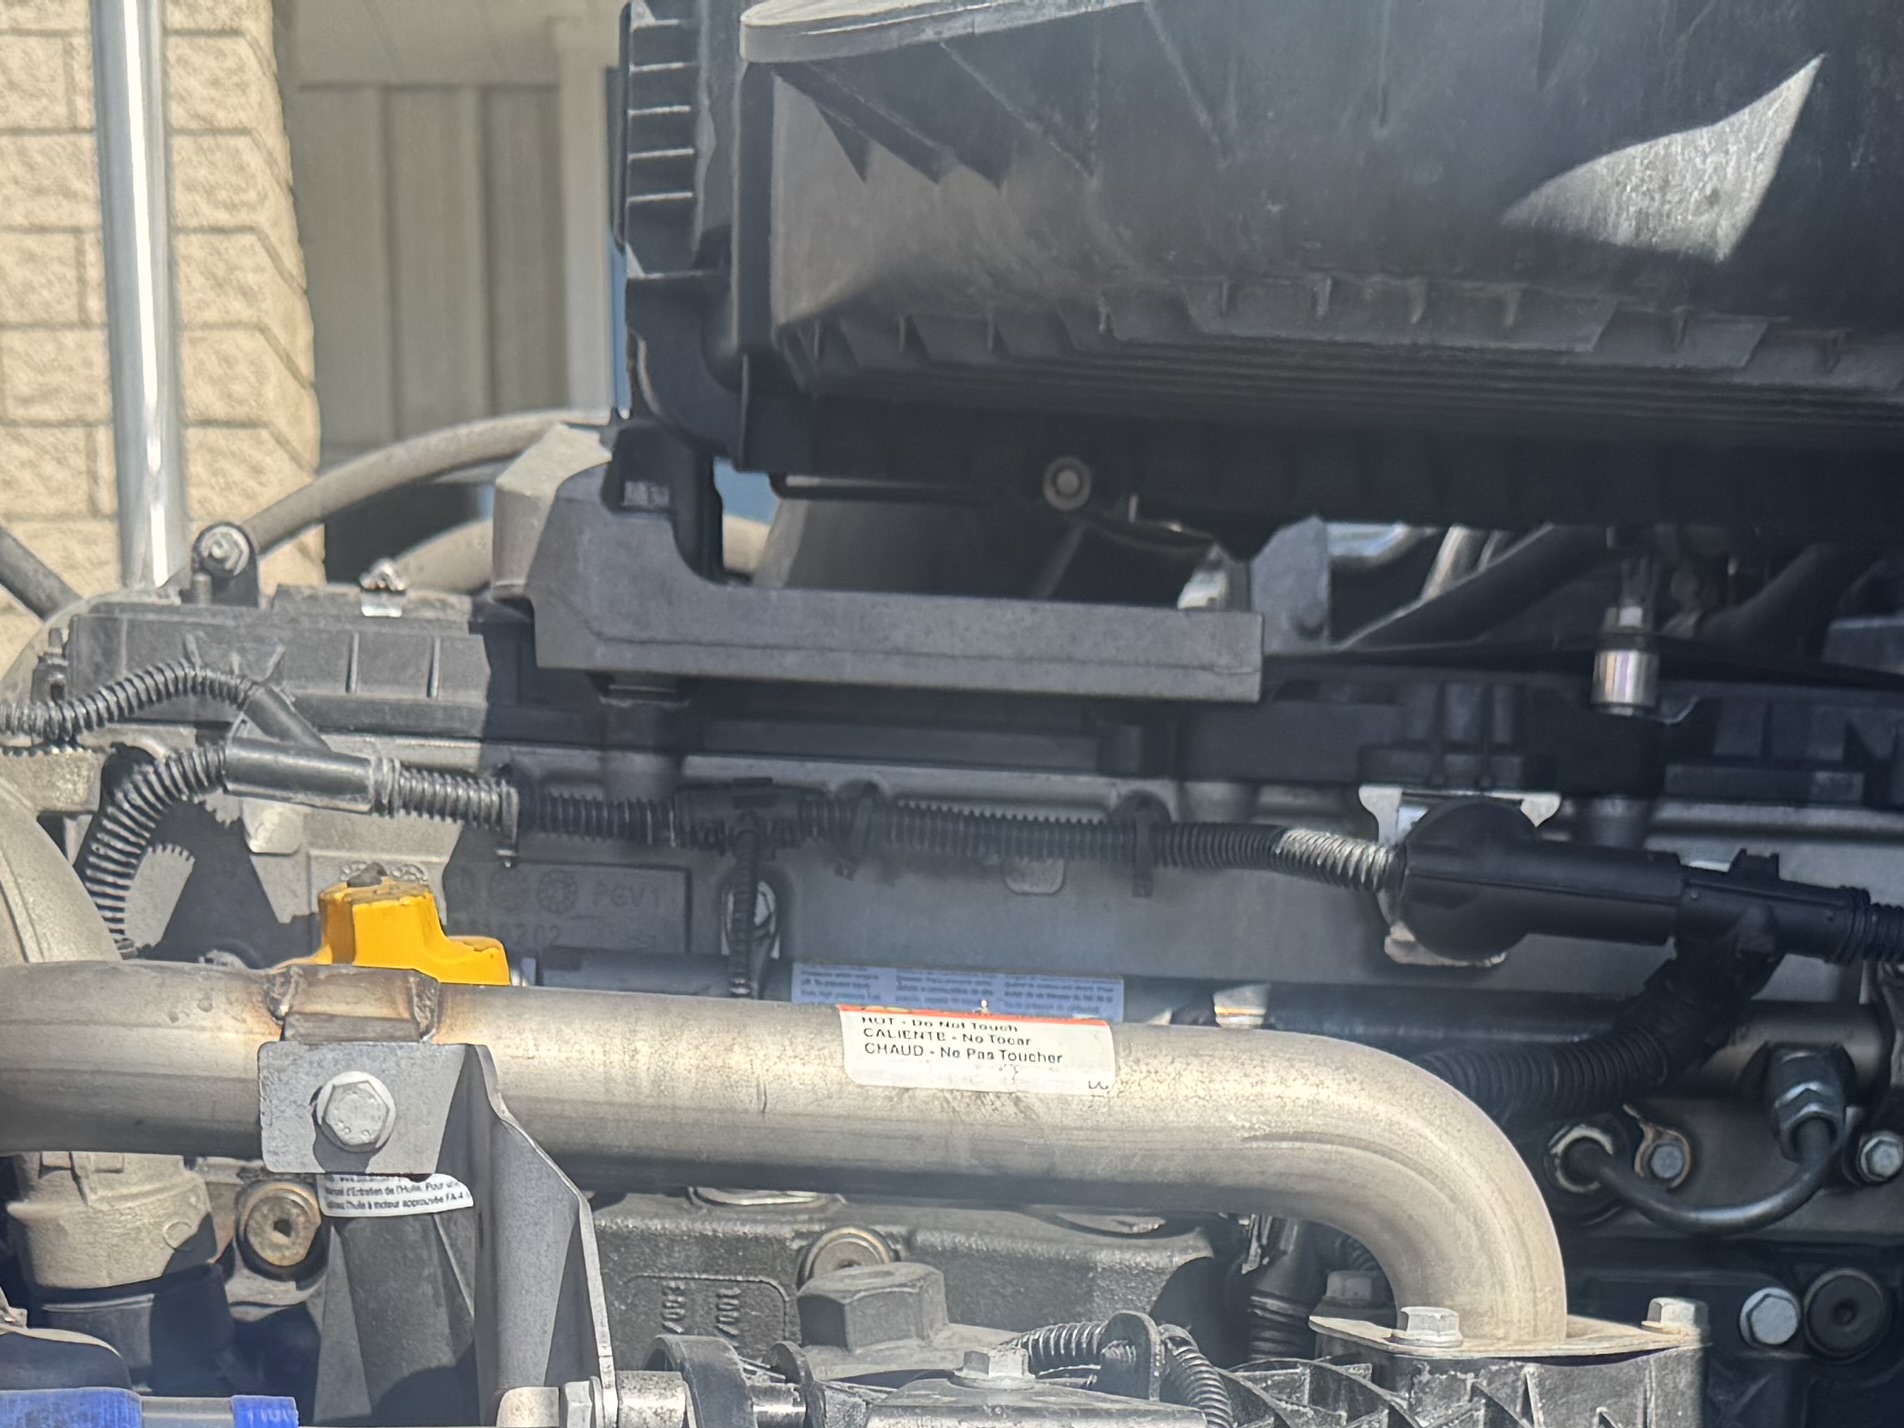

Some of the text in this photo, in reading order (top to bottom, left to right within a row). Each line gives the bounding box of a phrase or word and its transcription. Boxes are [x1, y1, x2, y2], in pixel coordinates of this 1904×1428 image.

[912, 1019, 933, 1028] Do
[969, 1022, 1018, 1032] Touch
[863, 1028, 1032, 1046] CALIENTE No Tocar
[864, 1043, 923, 1057] CHAUD
[1000, 1050, 1063, 1064] Toucher
